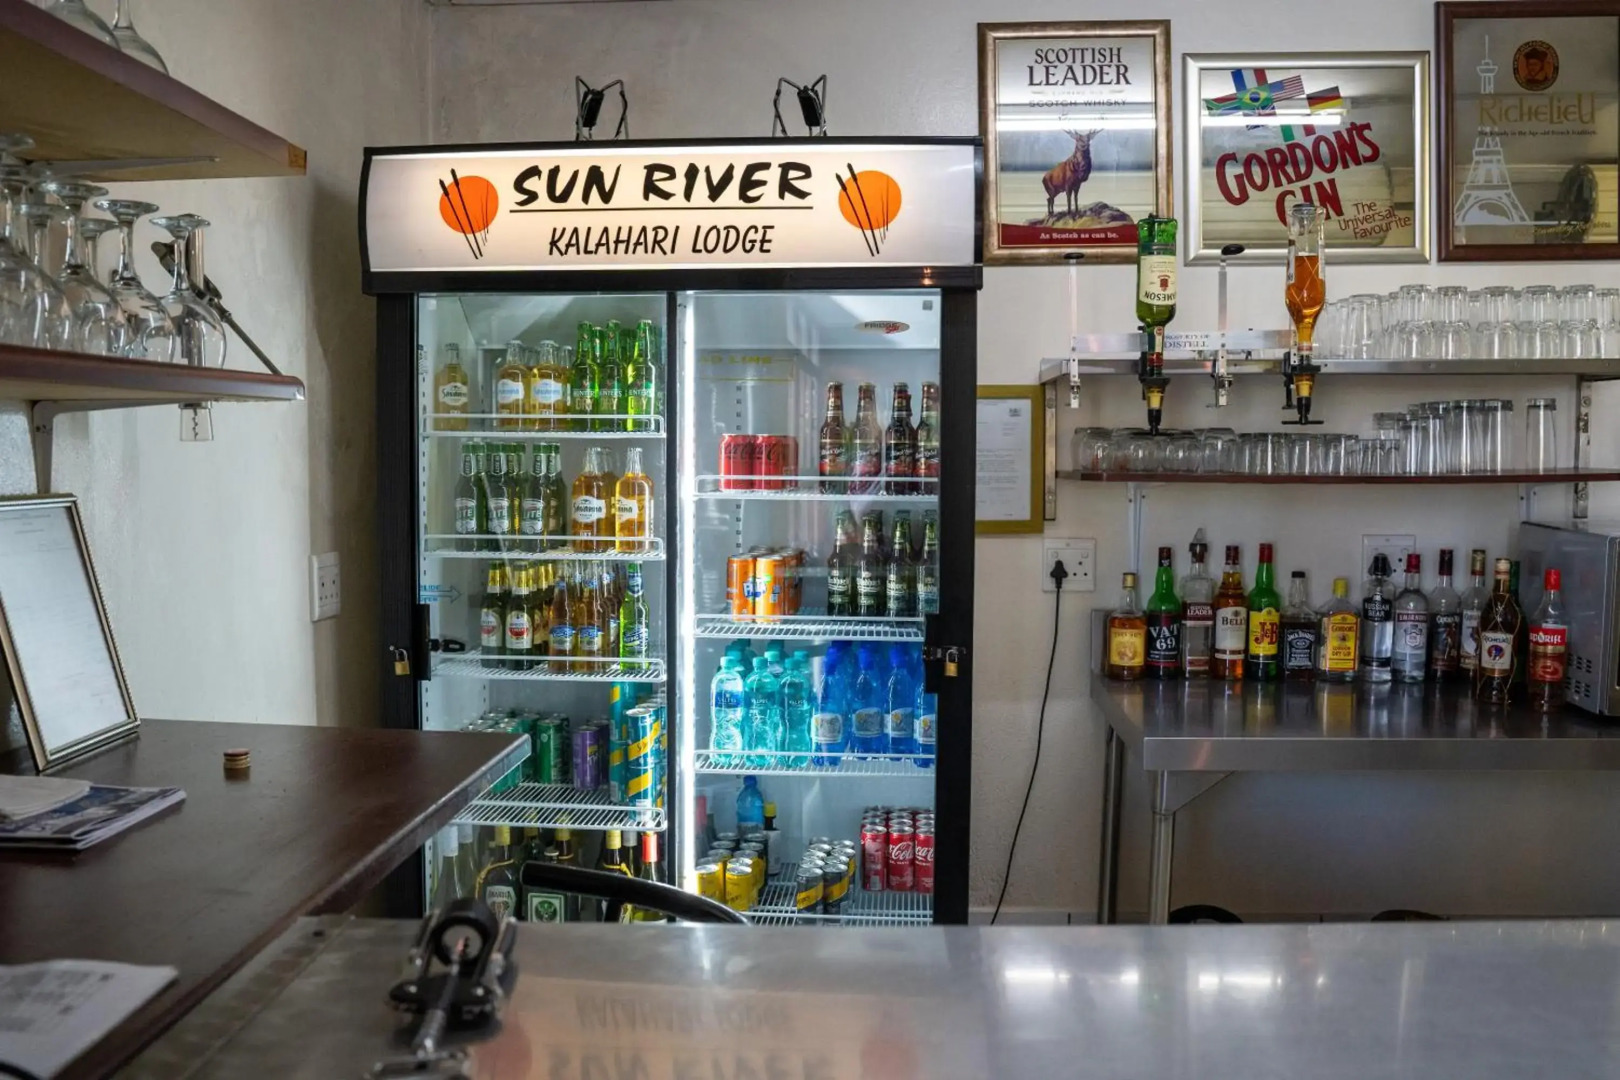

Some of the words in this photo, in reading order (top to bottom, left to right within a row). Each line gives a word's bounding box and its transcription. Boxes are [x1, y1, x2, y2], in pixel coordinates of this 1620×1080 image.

[1035, 47, 1122, 65] SCOTTISH
[1028, 64, 1132, 87] LEADER
[1029, 99, 1077, 107] SCOTCH
[1083, 98, 1127, 106] WHISKY
[1216, 122, 1380, 206] GORDON'S
[513, 163, 622, 207] SUN
[642, 160, 814, 203] RIVER
[1338, 206, 1399, 231] Universal
[1354, 201, 1378, 217] The
[1353, 215, 1412, 240] Favourite
[548, 225, 681, 257] KALAHARI
[691, 224, 775, 255] LODGE
[1365, 602, 1390, 610] RUSSIAN
[1149, 623, 1180, 639] VAT
[1254, 622, 1279, 645] J&B
[1156, 636, 1176, 650] 69
